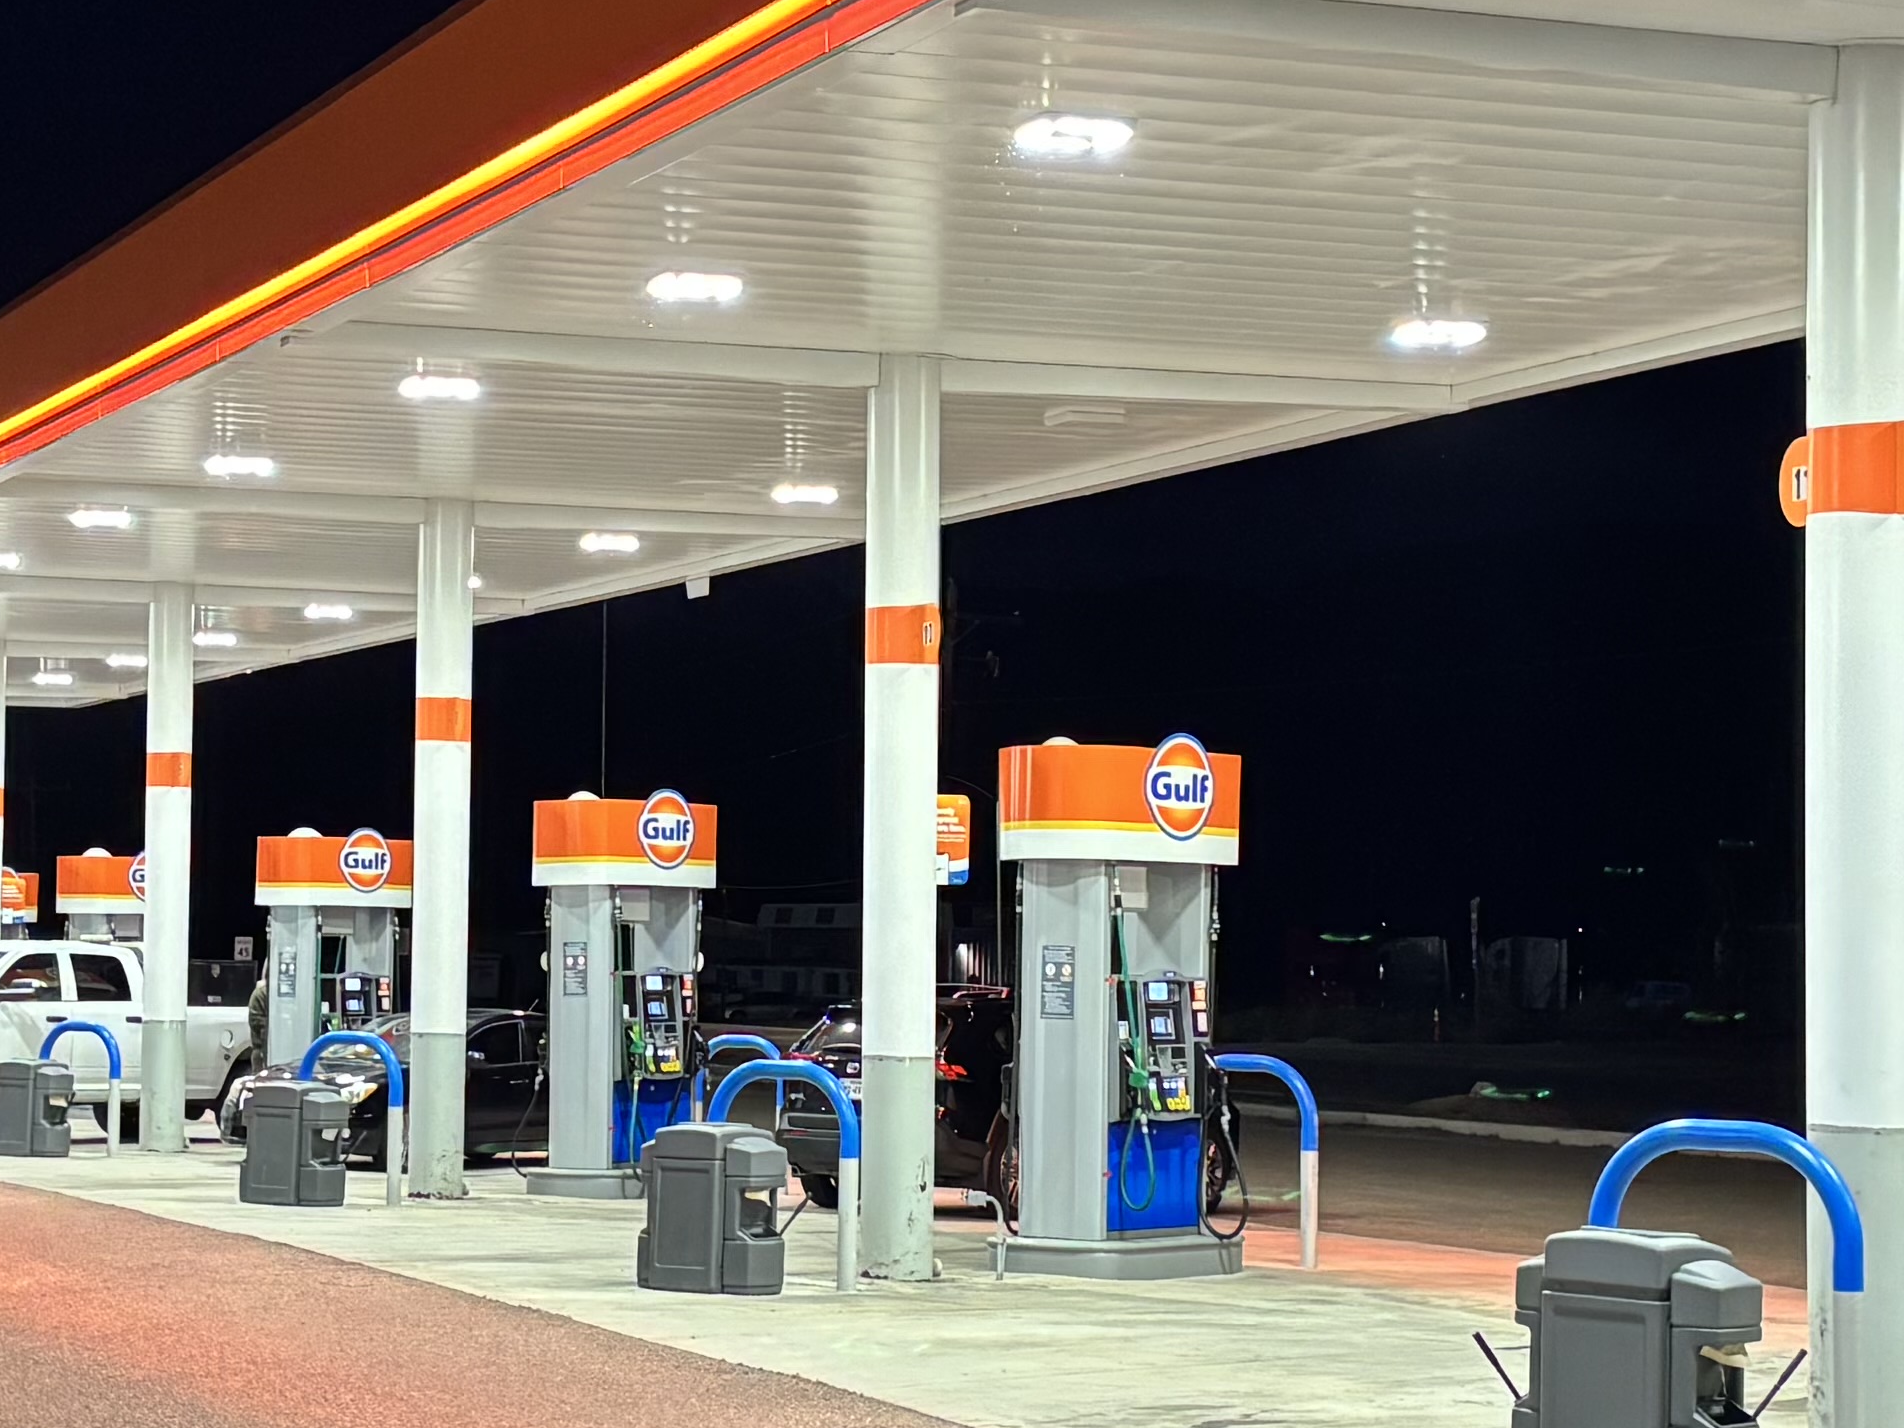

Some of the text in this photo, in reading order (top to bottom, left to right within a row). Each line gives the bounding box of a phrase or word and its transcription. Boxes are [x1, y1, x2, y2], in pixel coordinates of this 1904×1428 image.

[1794, 468, 1808, 500] 1
[1151, 771, 1209, 803] Gulf
[642, 817, 691, 842] Gulf
[344, 851, 387, 870] Gulf
